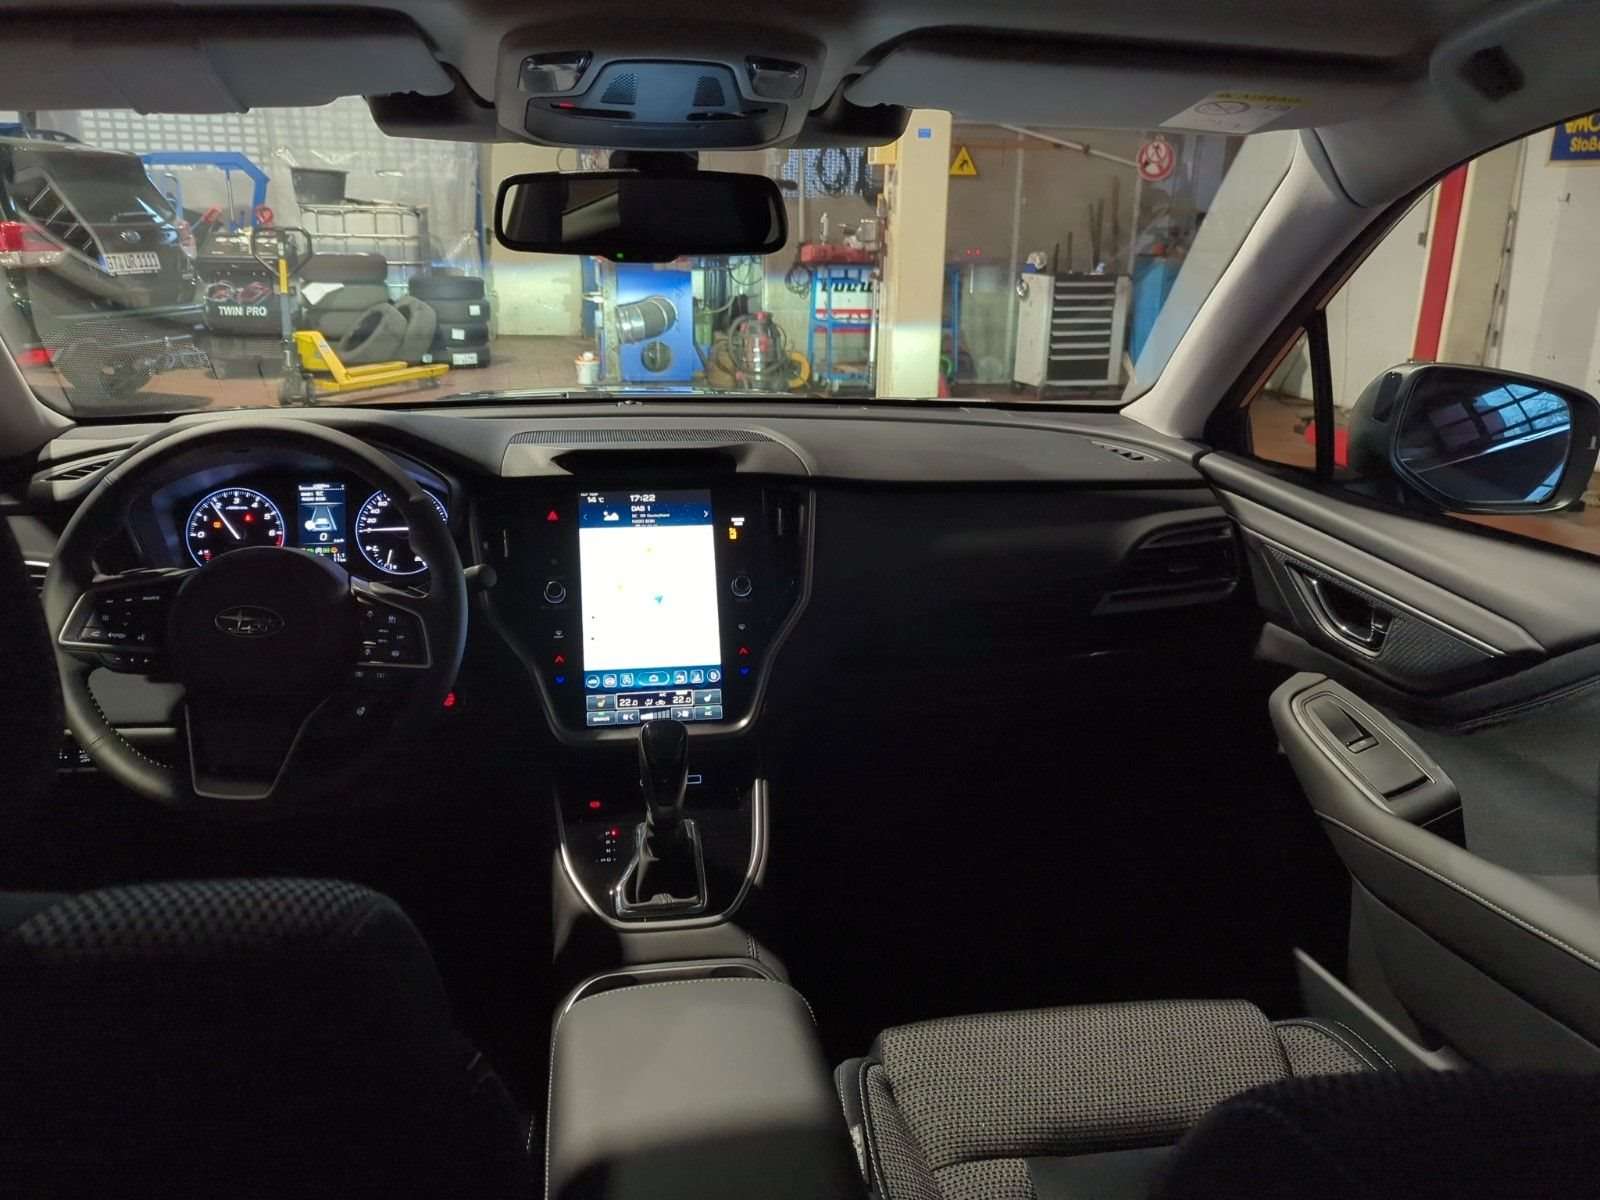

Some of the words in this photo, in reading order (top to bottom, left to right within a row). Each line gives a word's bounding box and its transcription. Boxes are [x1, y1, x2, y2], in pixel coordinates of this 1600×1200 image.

[218, 305, 243, 316] TWIN
[246, 305, 267, 316] PRO
[630, 494, 656, 502] 17:22
[268, 529, 276, 537] 6
[319, 532, 328, 541] 0
[619, 698, 639, 706] 22.0
[672, 695, 692, 703] 22.0
